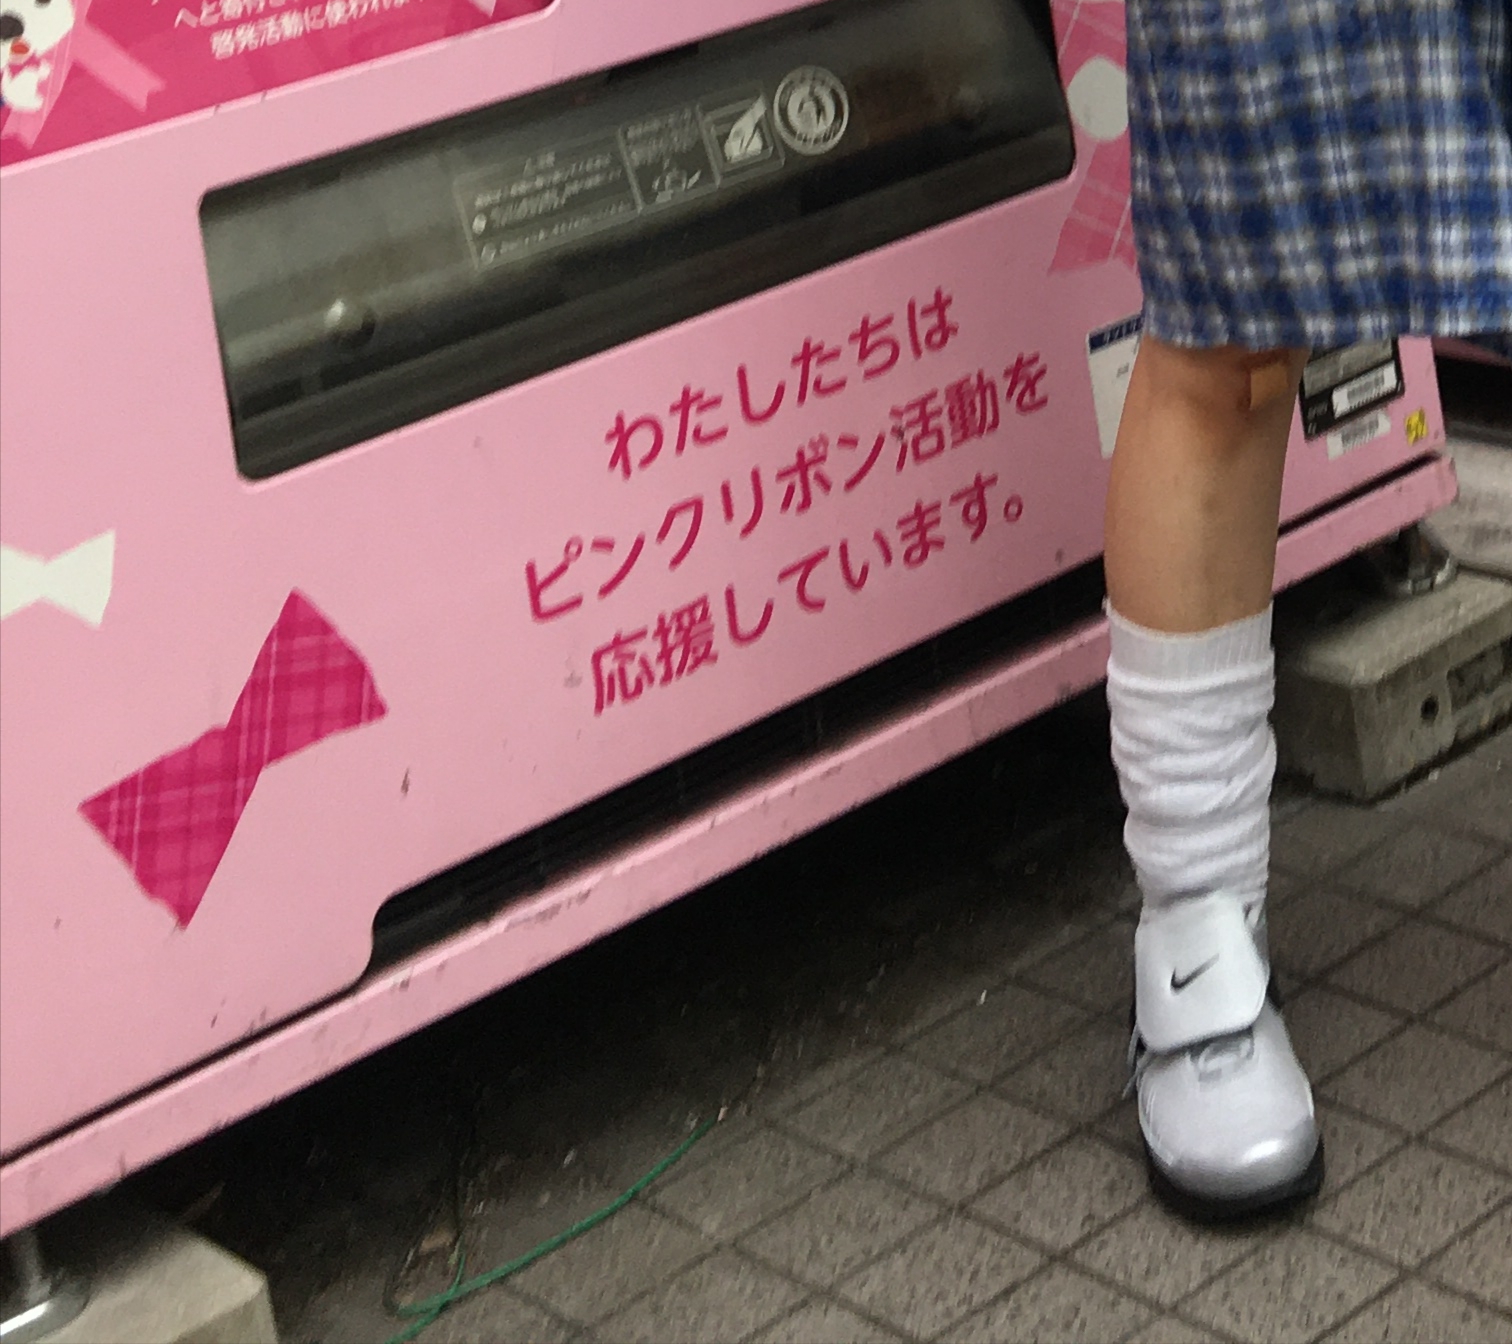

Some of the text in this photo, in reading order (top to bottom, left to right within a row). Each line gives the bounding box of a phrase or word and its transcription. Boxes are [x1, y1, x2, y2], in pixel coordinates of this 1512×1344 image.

[524, 351, 1052, 623] ピンクリボン活動を
[605, 285, 960, 481] わたしたちは
[588, 469, 1026, 718] 応援しています。
